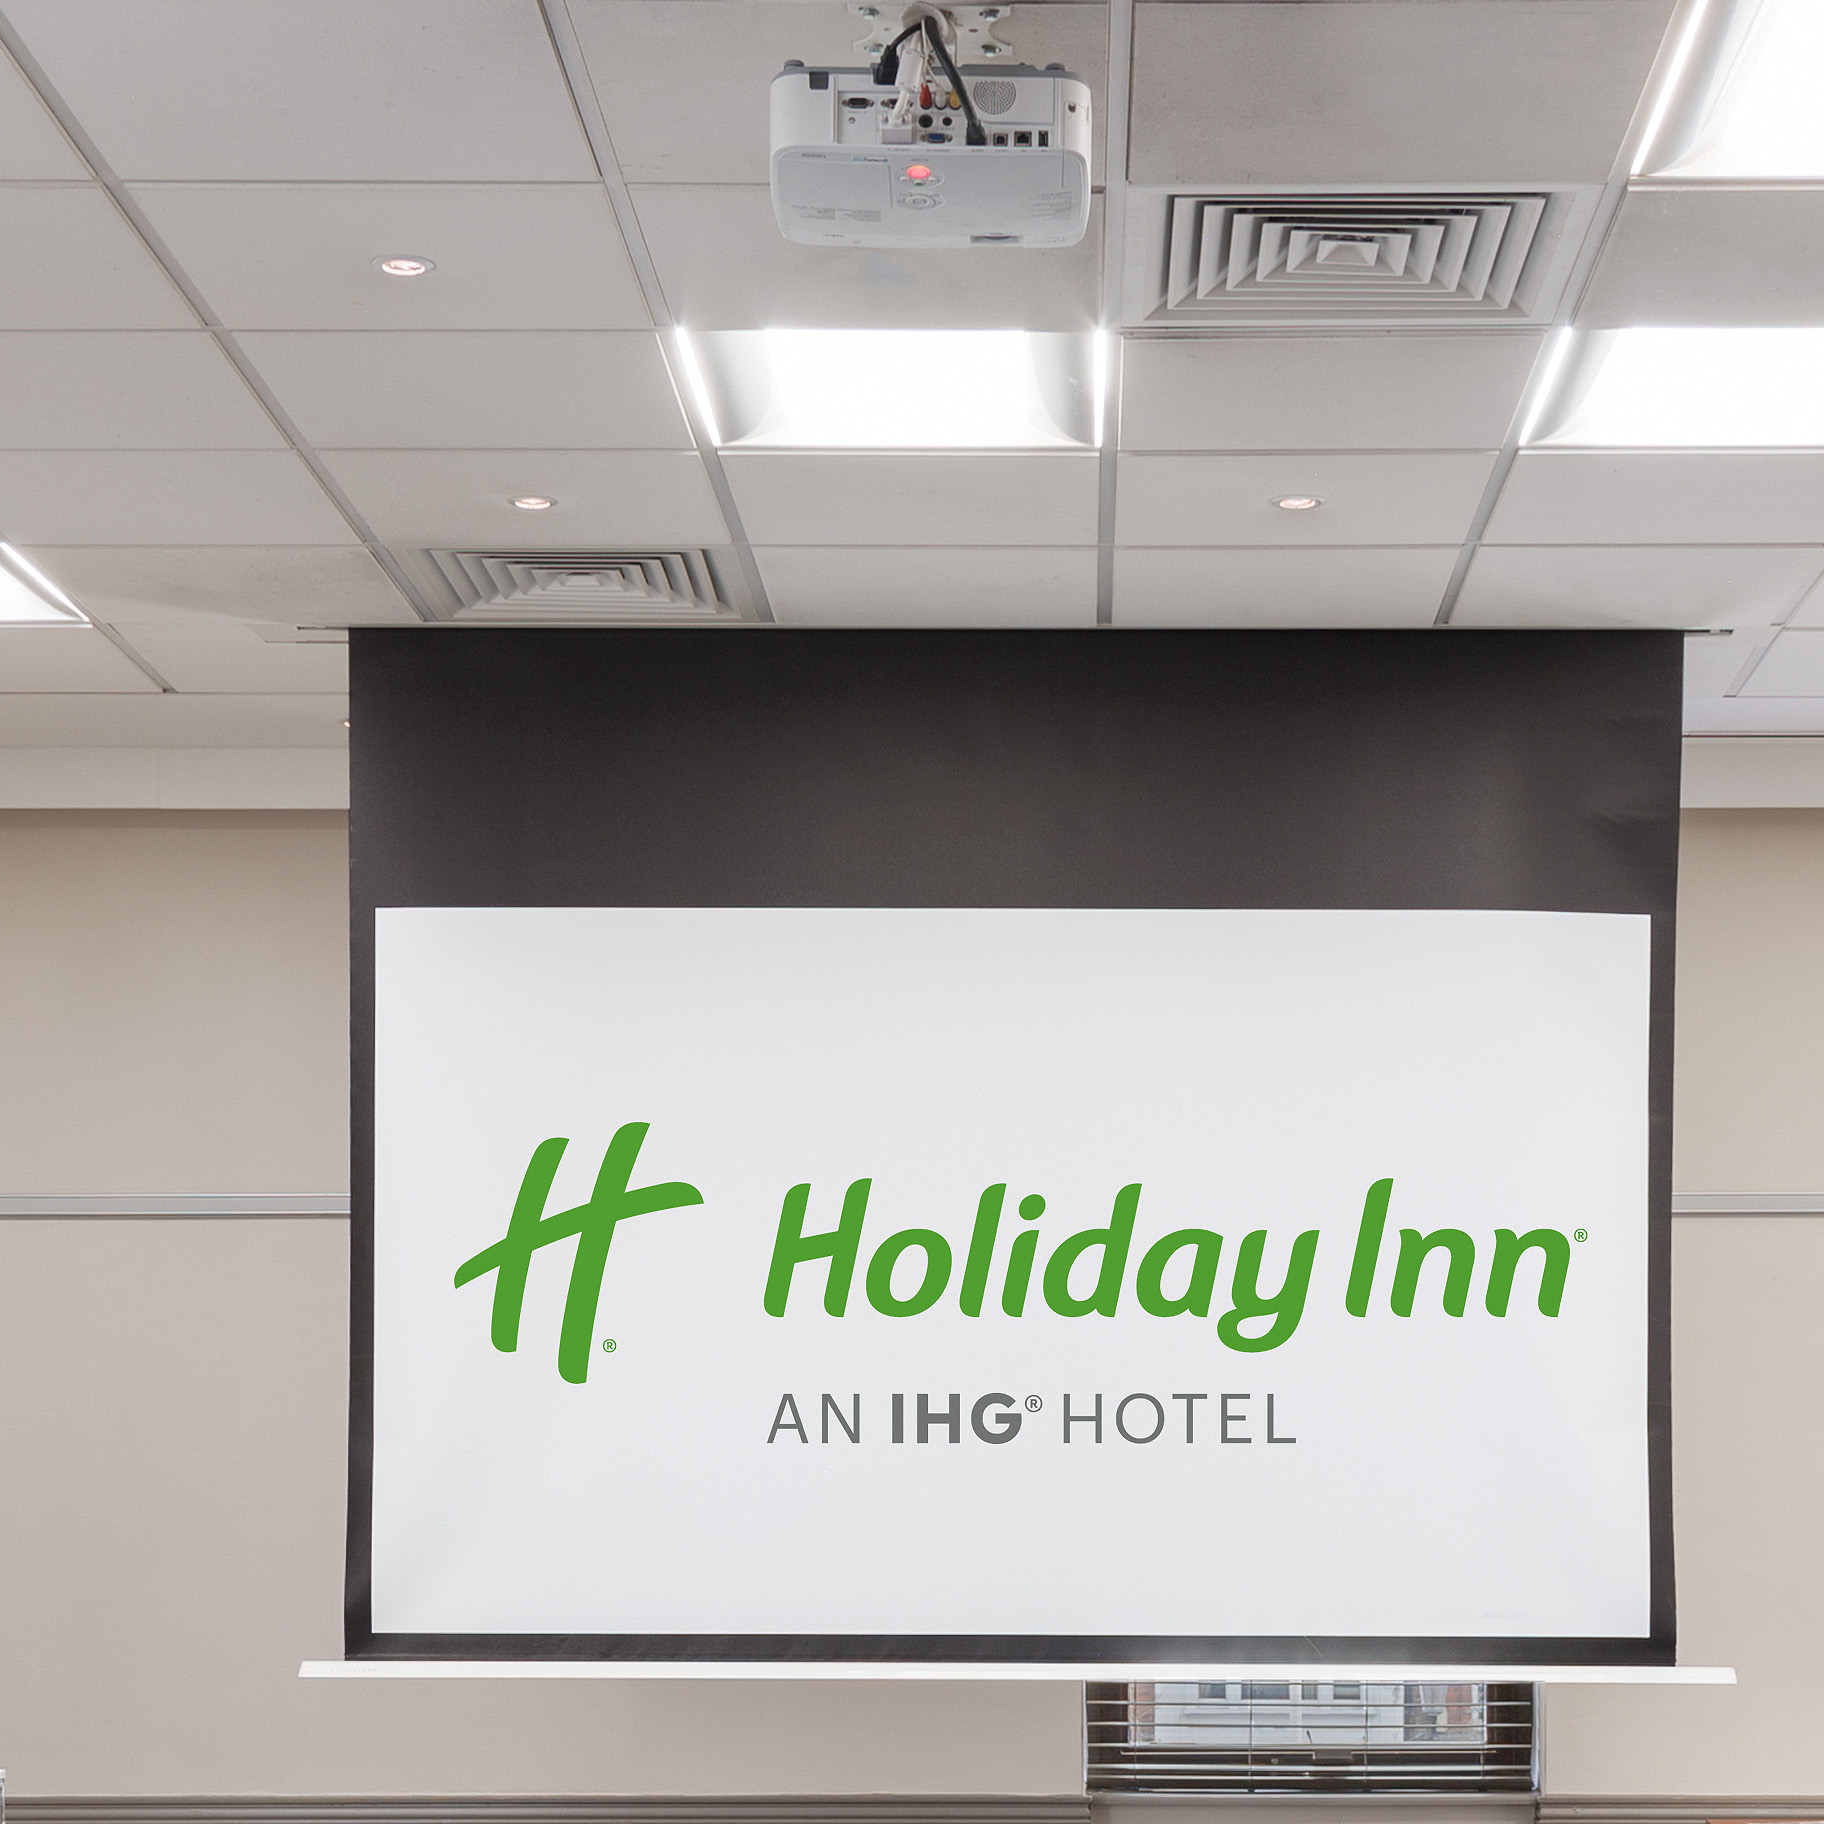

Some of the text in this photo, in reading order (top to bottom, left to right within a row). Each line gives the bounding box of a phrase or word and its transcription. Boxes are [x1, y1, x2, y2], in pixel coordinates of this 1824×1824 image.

[763, 1177, 1320, 1353] Holiday
[766, 1393, 861, 1444] AN
[1063, 1392, 1297, 1445] HOTEL
